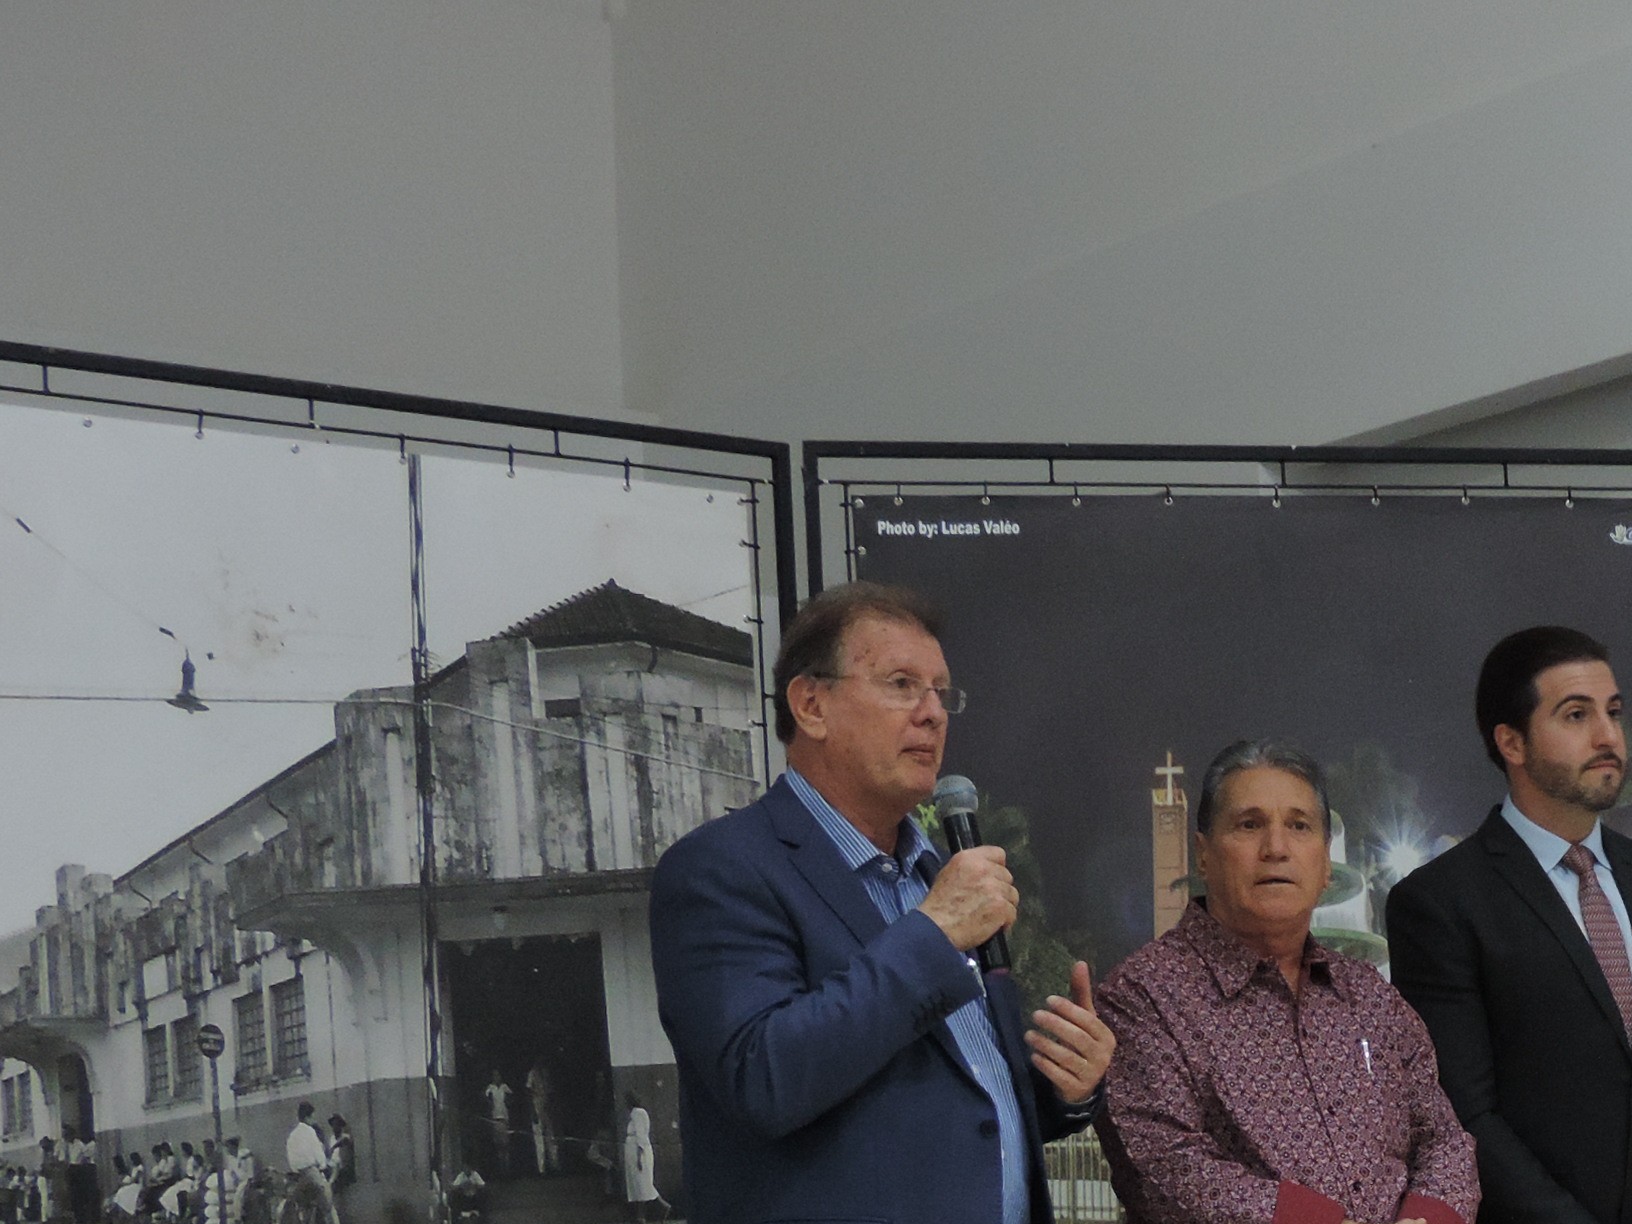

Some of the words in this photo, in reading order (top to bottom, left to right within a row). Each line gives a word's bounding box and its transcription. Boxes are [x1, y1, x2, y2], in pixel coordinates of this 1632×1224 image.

[877, 520, 915, 535] Photo
[919, 521, 938, 538] by:
[942, 521, 980, 535] Lucas
